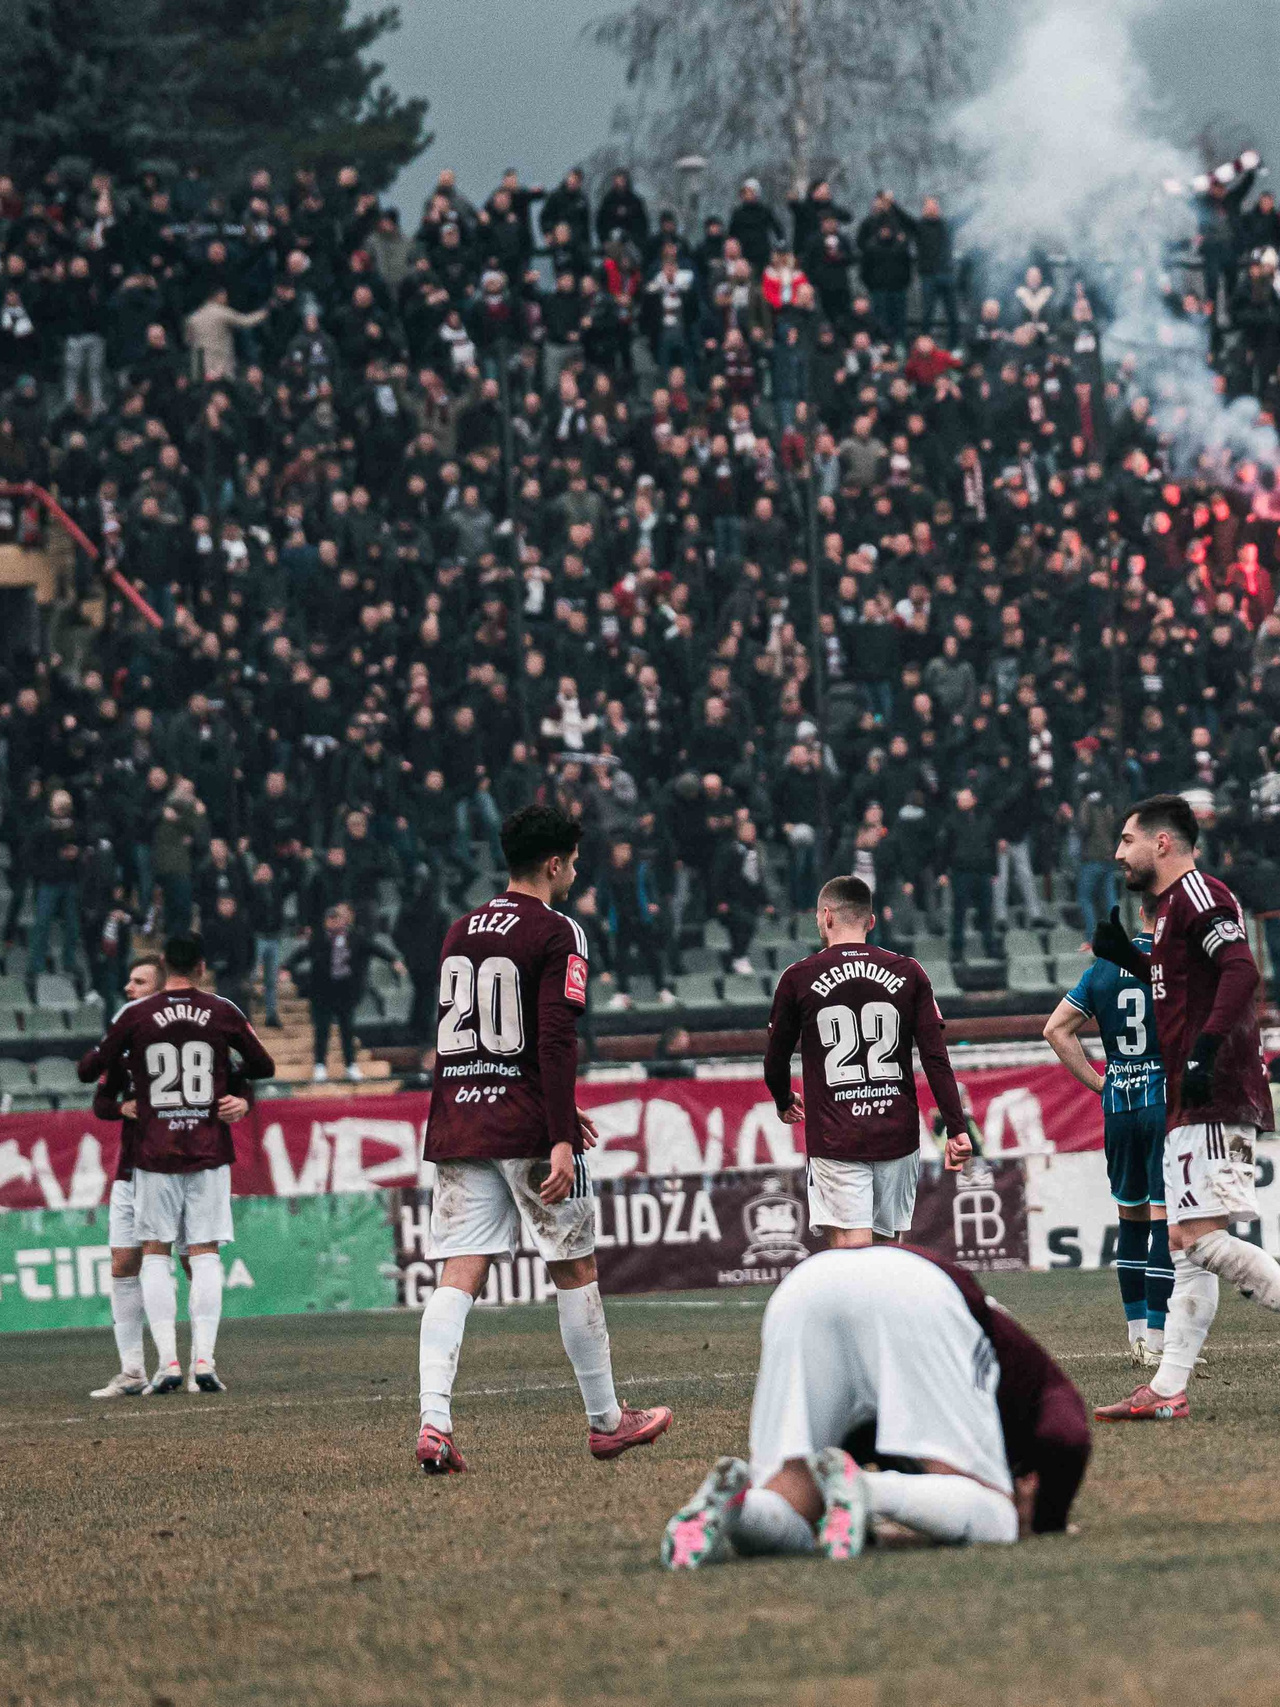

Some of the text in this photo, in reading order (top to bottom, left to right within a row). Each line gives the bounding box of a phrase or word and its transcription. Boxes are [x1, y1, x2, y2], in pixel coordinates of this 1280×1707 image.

[467, 912, 520, 936] ELEZI
[437, 955, 525, 1056] 20
[810, 960, 907, 998] BEGANOVIĆ
[816, 1001, 903, 1087] 22
[1116, 988, 1147, 1056] 3
[145, 1040, 215, 1109] 28
[1107, 1060, 1161, 1075] ADMIRAL
[1178, 1151, 1194, 1187] 7
[595, 1186, 722, 1247] LIDŽA
